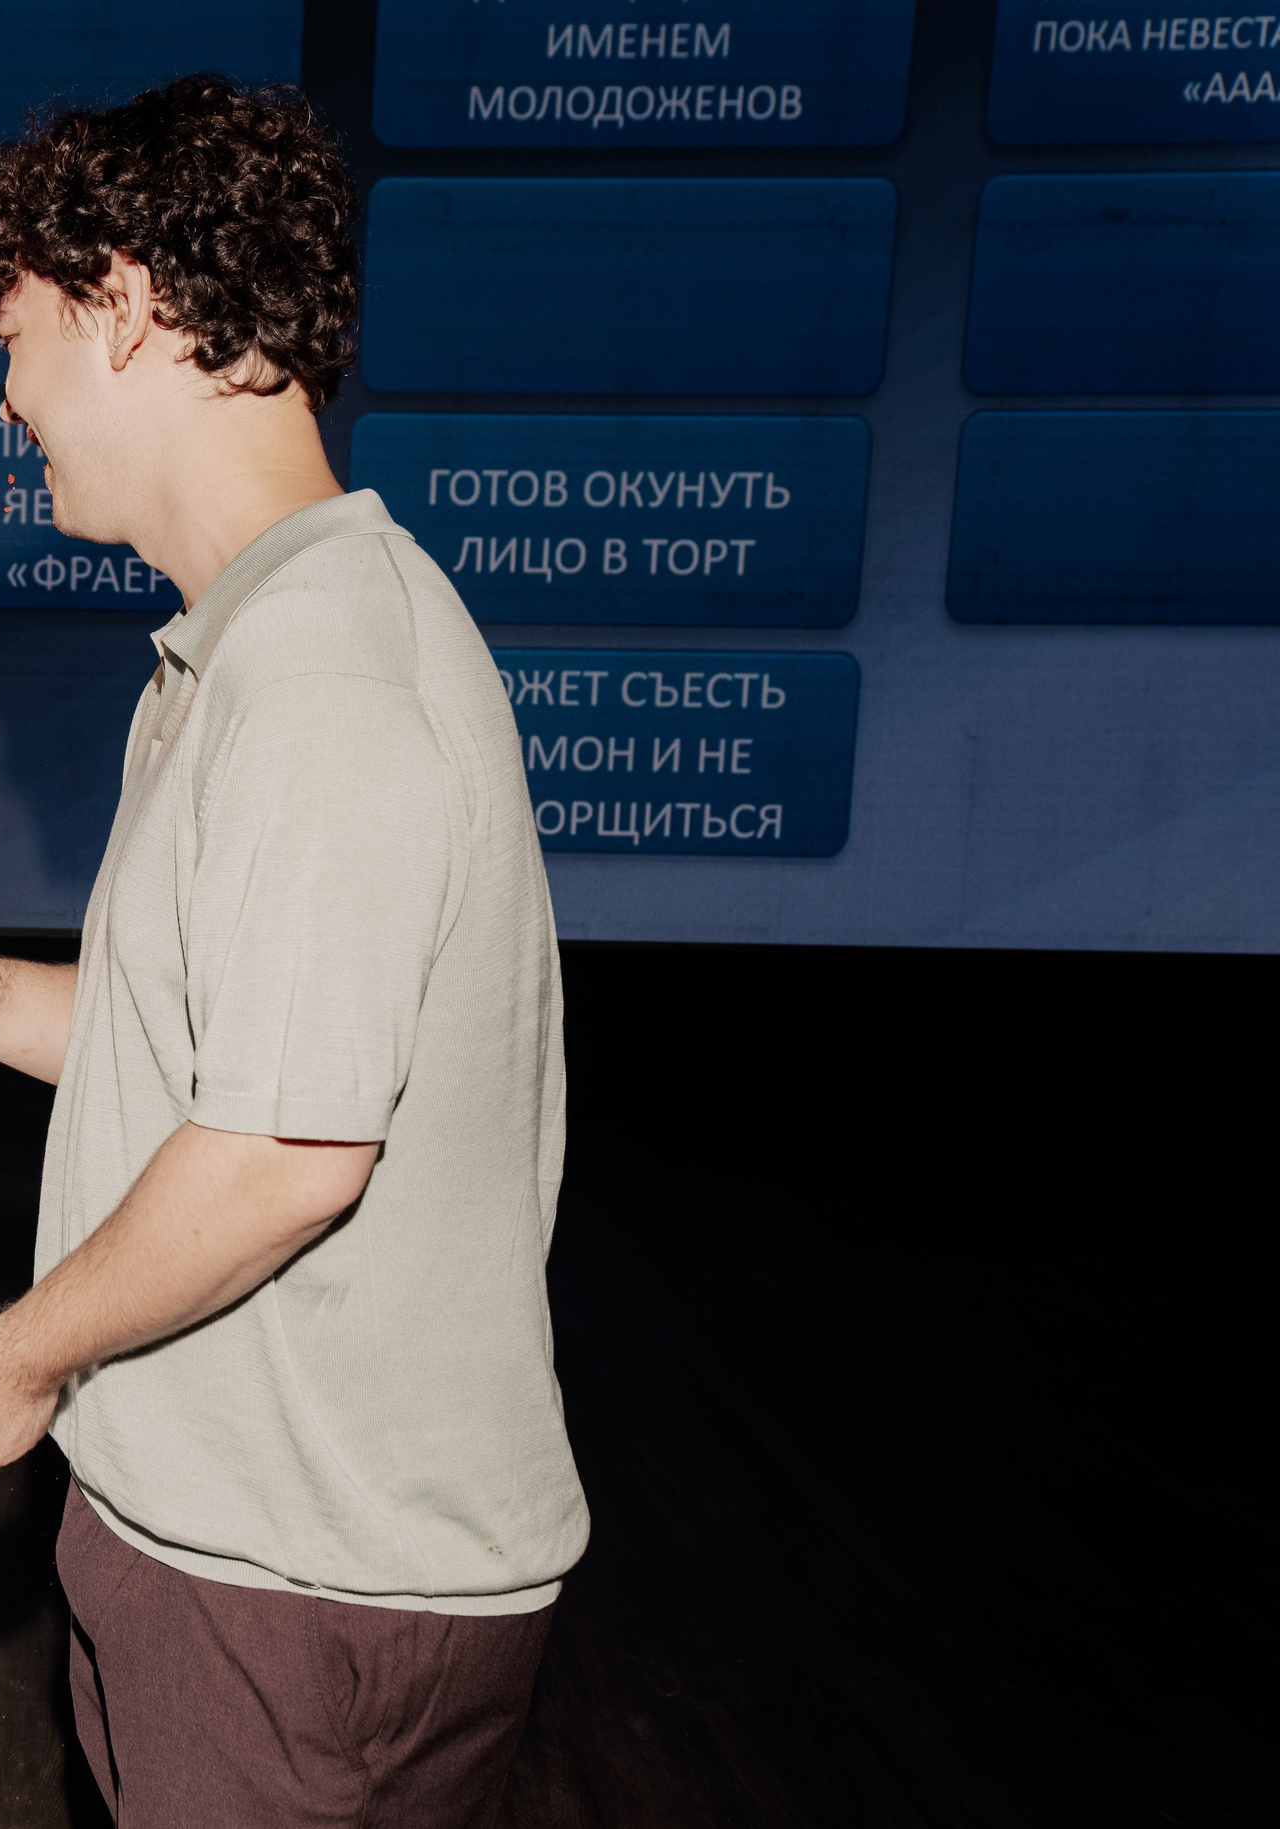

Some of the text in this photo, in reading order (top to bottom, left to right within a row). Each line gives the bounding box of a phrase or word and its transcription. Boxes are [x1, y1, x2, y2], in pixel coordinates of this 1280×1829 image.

[548, 24, 729, 57] ИМЕНЕМ
[1035, 21, 1130, 50] ПОКА
[1185, 72, 1280, 101] «ААА
[470, 86, 801, 126] МОЛОДОЖЕНОВ
[430, 470, 789, 508] ГОТОВ ОКУНУТЬ
[453, 537, 754, 582] ЛИЦО В ТОРТ
[622, 672, 785, 708] СЪЕСТЬ
[519, 735, 751, 773] МОН И НЕ
[535, 801, 782, 846] ОРЩИТЬСЯ
